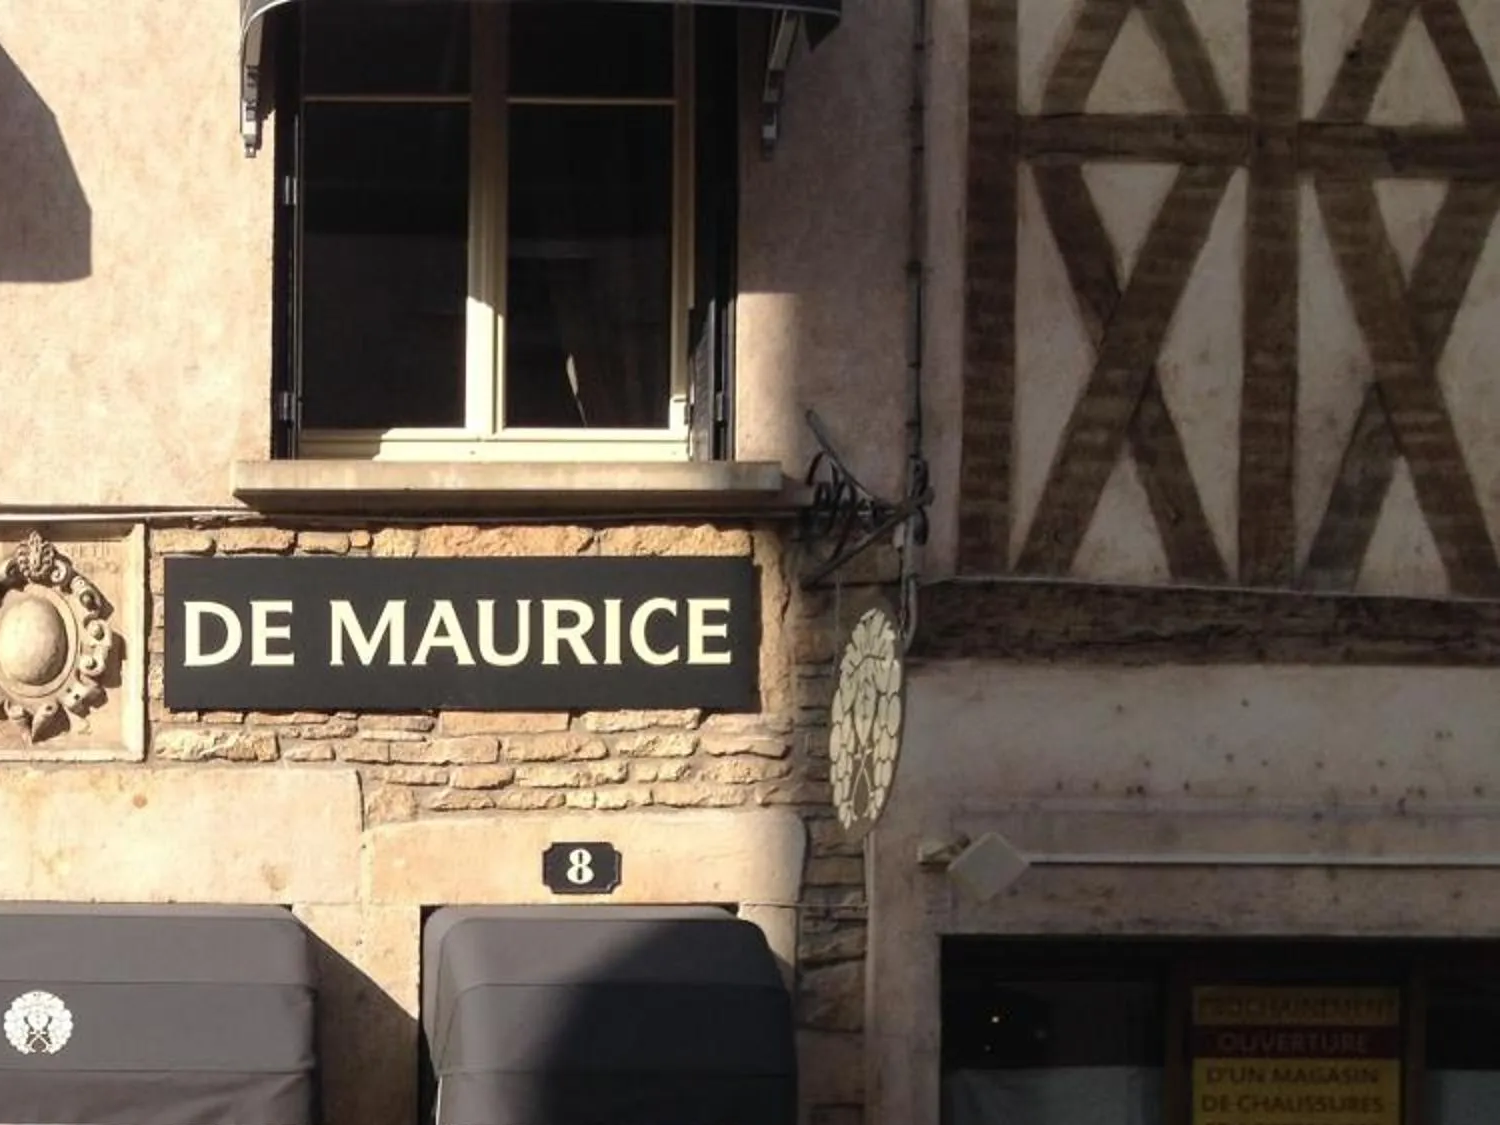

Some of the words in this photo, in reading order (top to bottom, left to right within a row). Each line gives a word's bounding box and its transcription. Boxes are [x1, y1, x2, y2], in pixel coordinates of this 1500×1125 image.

[182, 599, 295, 667] DE
[328, 597, 733, 667] MAURICE
[565, 847, 595, 886] 8
[1217, 1032, 1369, 1053] OUVERTURE
[1206, 1066, 1265, 1084] D'UN
[1272, 1066, 1380, 1085] MAGASIN
[1202, 1095, 1231, 1113] DE
[1236, 1095, 1386, 1114] CHAUSSURES
